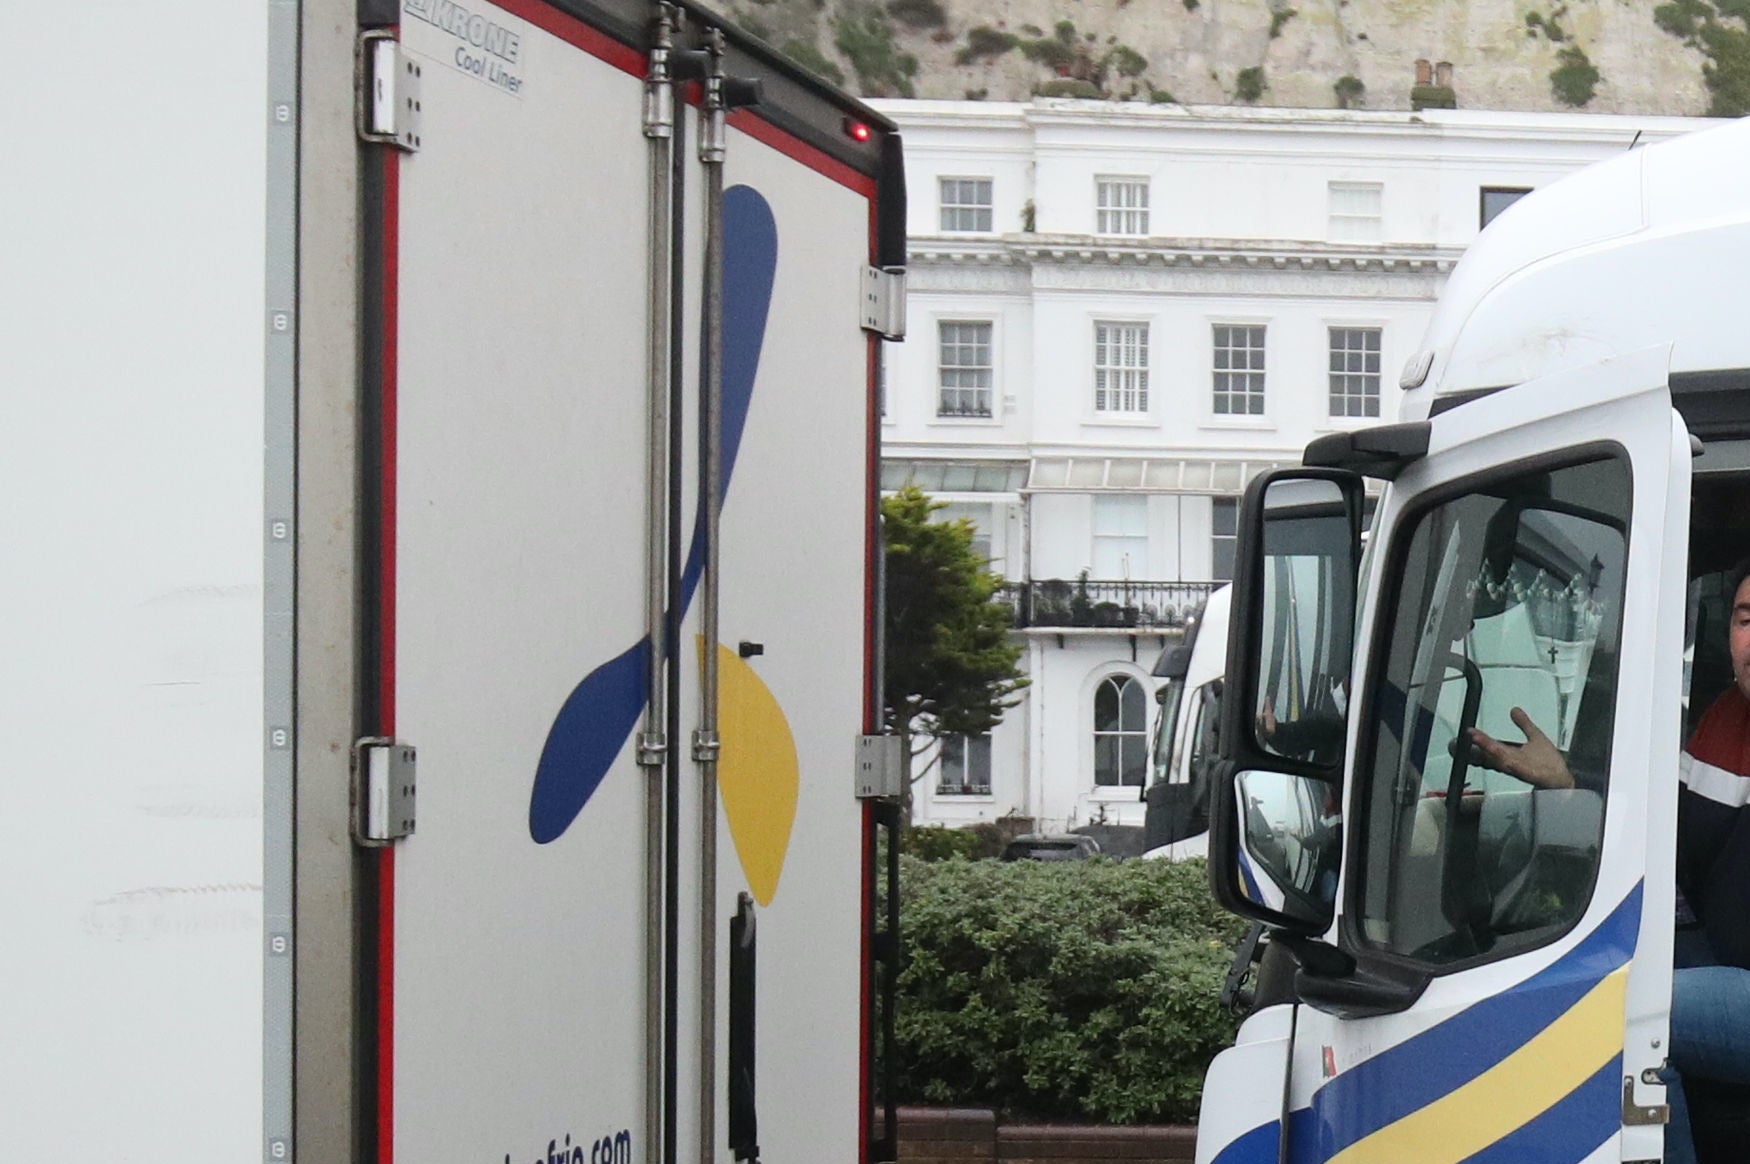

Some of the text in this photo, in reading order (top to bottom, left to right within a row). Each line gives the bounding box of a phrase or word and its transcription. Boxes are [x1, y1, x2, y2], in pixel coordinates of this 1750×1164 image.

[430, 0, 520, 64] KRONE
[455, 46, 523, 92] Cool Liner
